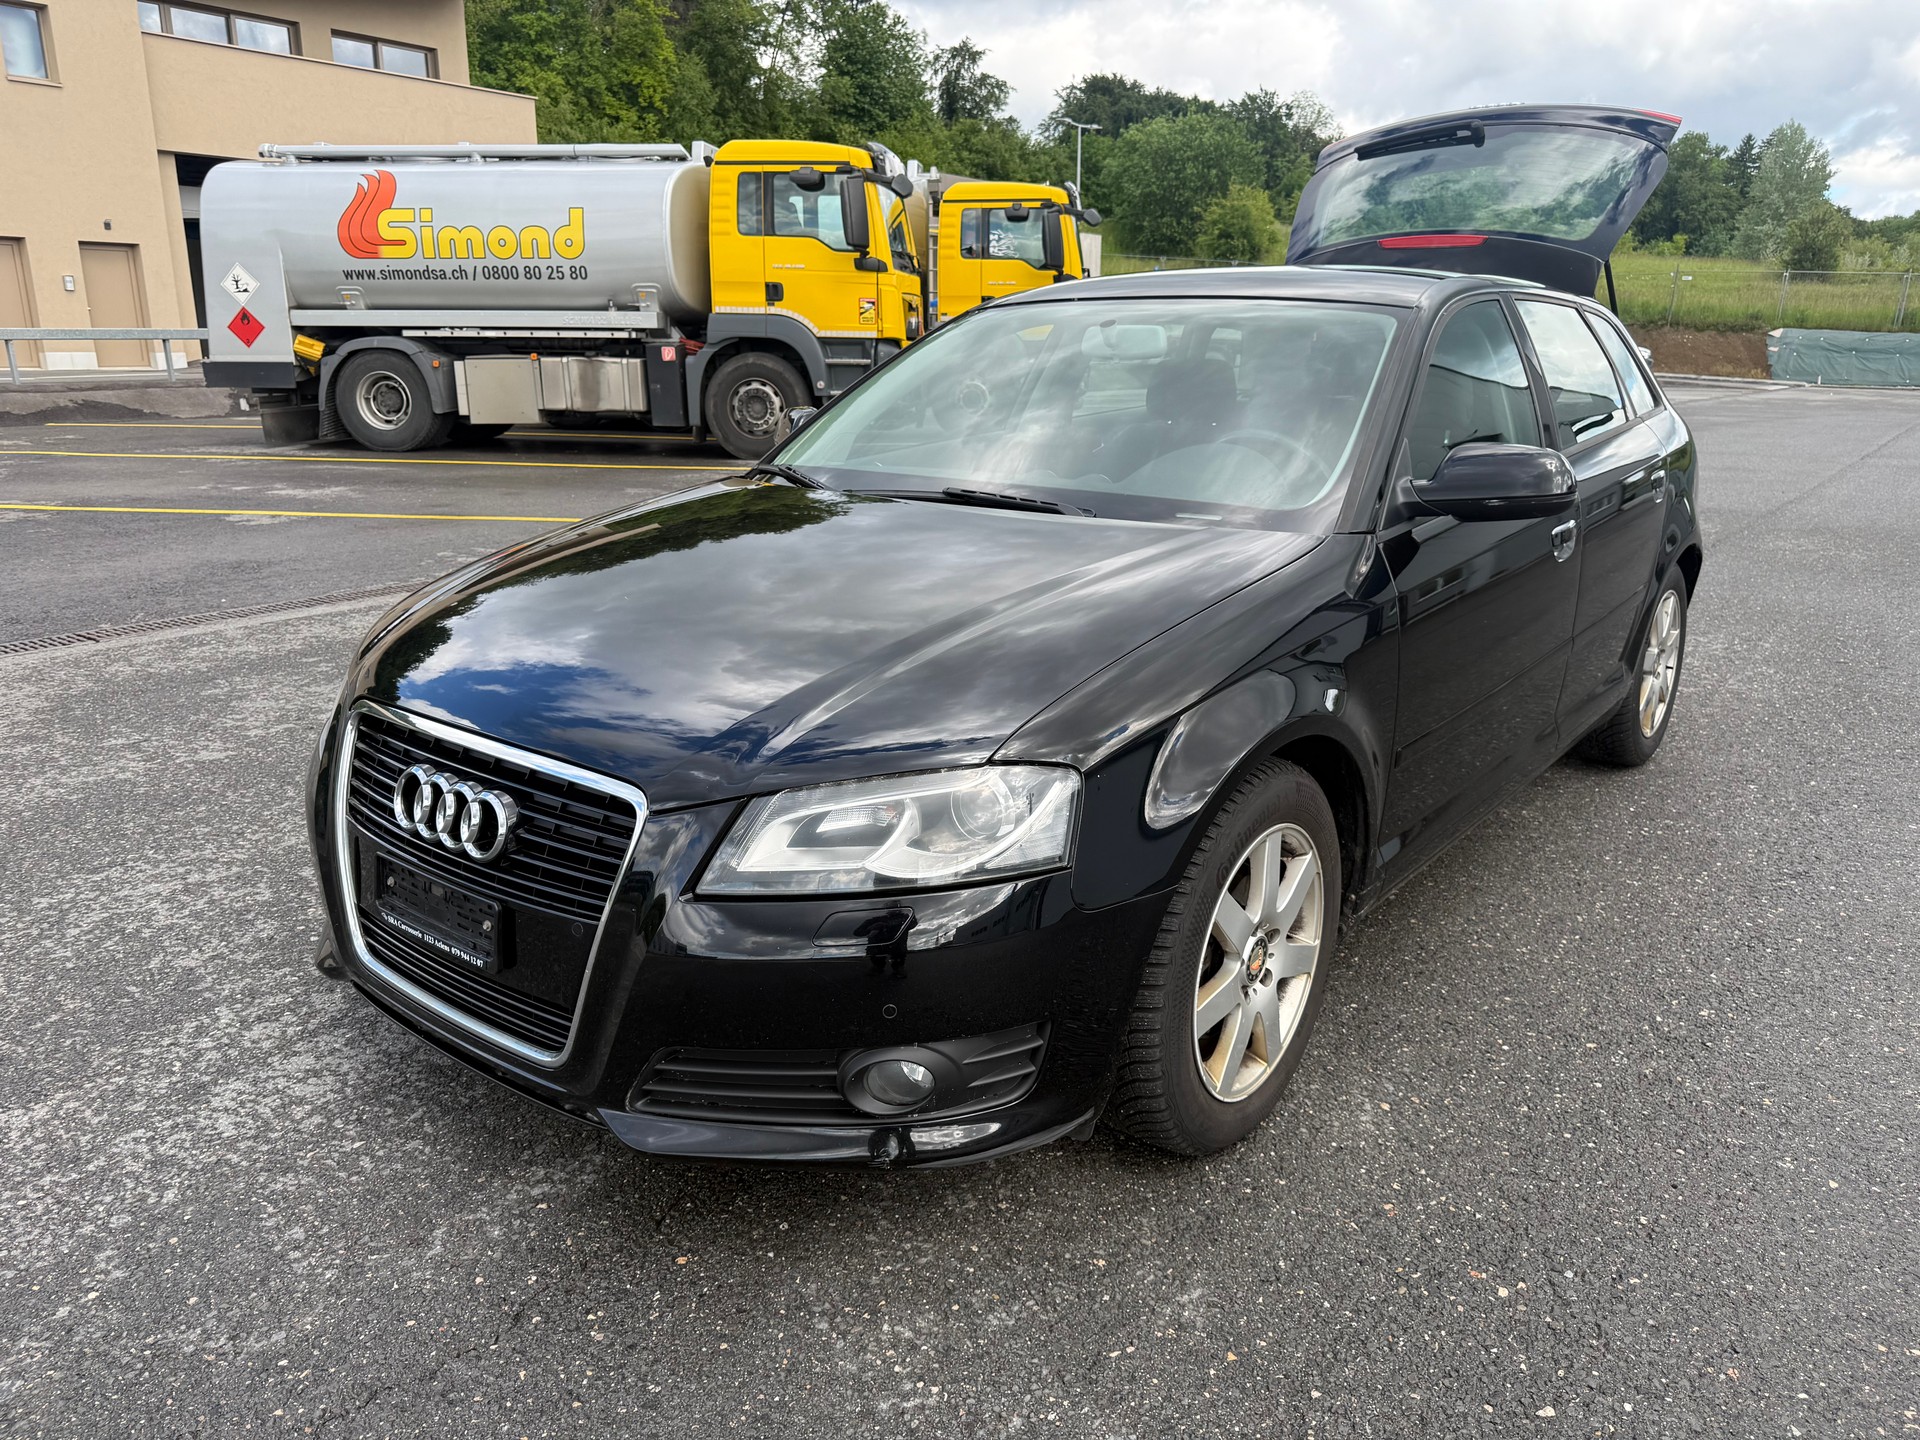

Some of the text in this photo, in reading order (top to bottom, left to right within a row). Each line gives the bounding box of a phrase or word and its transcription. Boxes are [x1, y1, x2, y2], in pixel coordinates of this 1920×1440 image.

[377, 207, 585, 260] Simond
[342, 264, 469, 281] www.simondsa.ch
[482, 265, 519, 281] 0800
[524, 265, 542, 281] 80
[547, 265, 565, 281] 25
[569, 265, 588, 281] 80
[423, 933, 434, 945] 1123
[461, 952, 469, 962] 944
